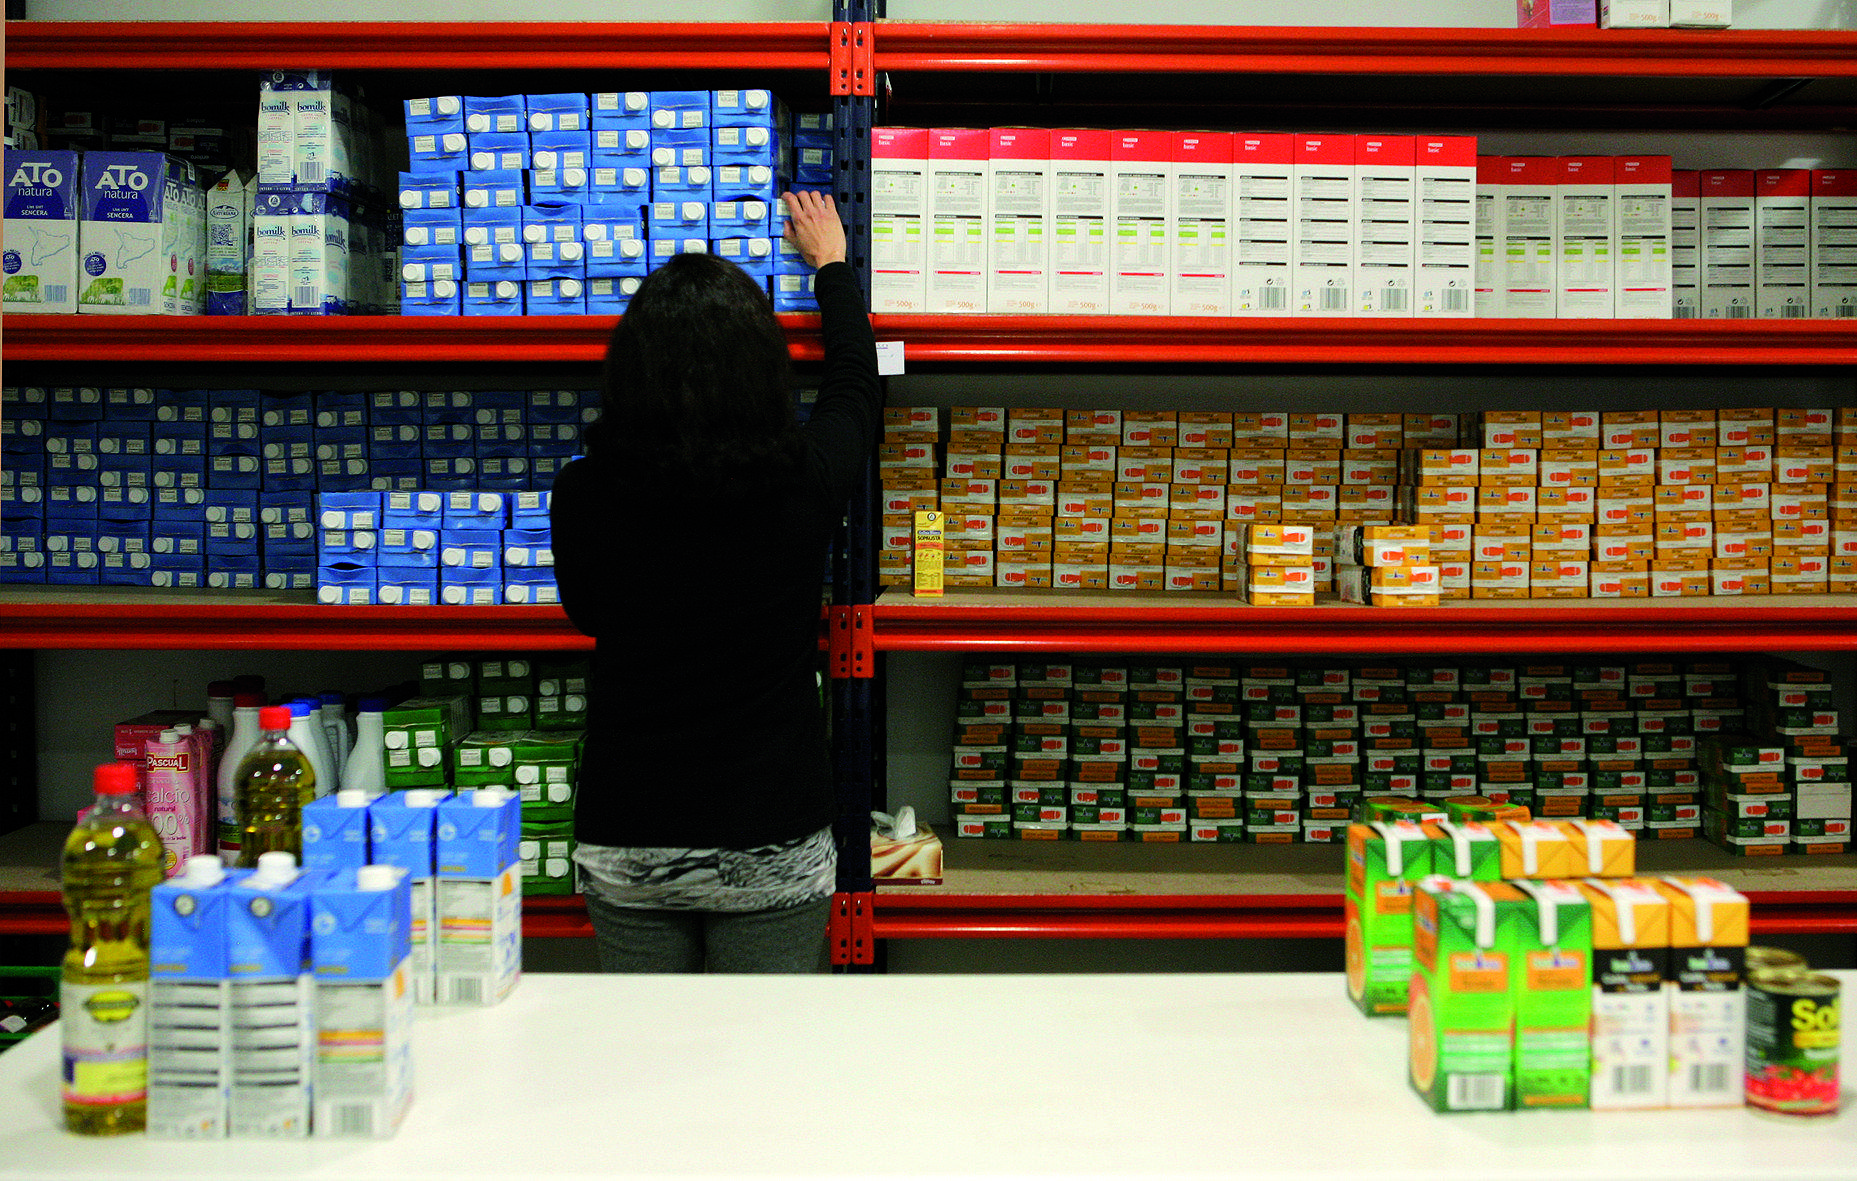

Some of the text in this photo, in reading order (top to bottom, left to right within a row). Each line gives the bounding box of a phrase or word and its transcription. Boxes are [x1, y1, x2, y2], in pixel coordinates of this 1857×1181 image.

[261, 100, 290, 112] bomilk
[297, 100, 326, 112] bomilk
[9, 162, 63, 188] ATO
[95, 165, 149, 190] ATO
[18, 187, 53, 197] natura
[104, 190, 138, 199] natura
[257, 225, 286, 236] bomilk
[292, 225, 320, 236] bomilk
[896, 300, 912, 309] 500g
[957, 300, 973, 310] 500g
[1018, 300, 1035, 309] 500g
[1079, 300, 1096, 310] 500g
[1140, 301, 1157, 311] 500g
[1201, 302, 1218, 311] 500g
[147, 756, 187, 770] PASCUAL
